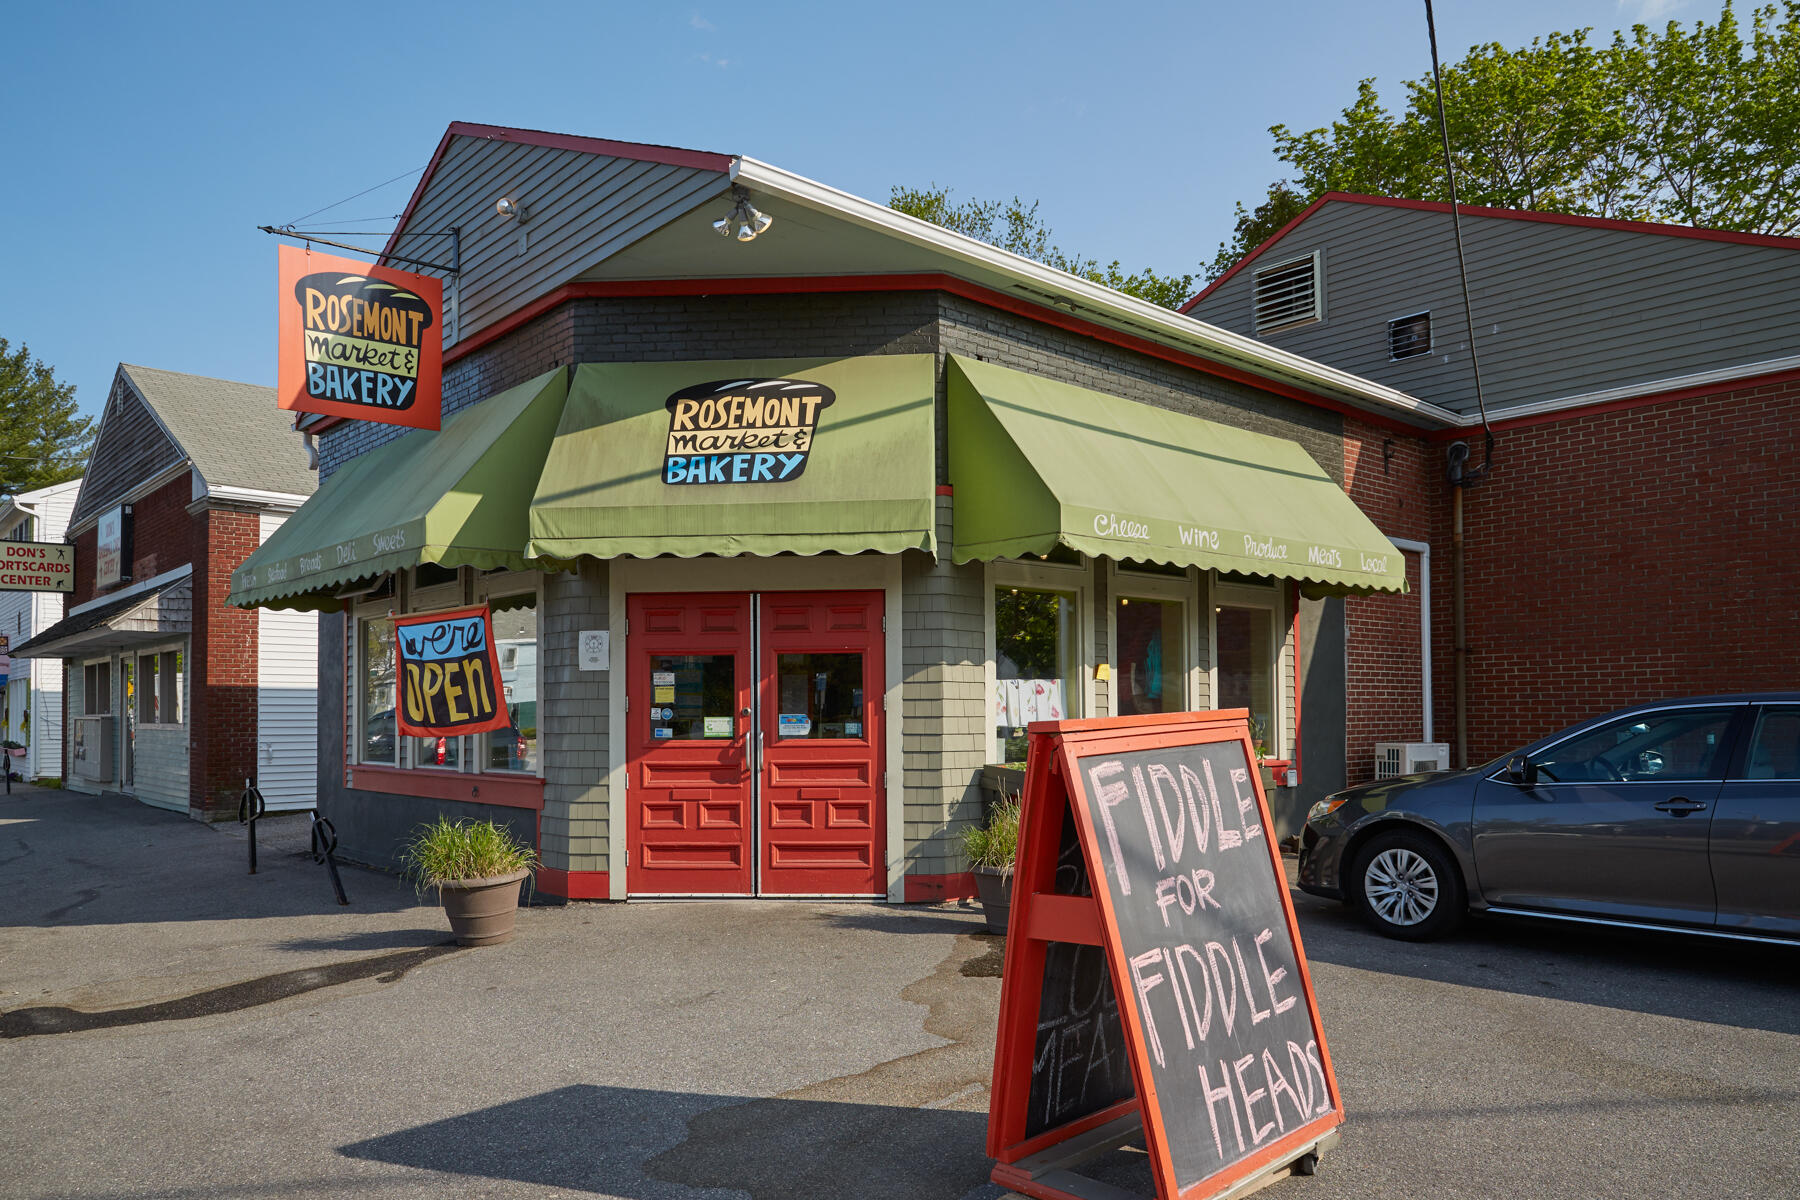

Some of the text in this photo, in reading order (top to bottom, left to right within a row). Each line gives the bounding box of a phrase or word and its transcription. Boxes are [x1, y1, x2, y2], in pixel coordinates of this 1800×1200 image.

[306, 287, 424, 346] ROSEMONT
[308, 362, 414, 406] BAKERY
[673, 396, 822, 430] ROSEMONT
[667, 453, 805, 484] BAKERY
[7, 546, 46, 559] DON'S
[336, 541, 357, 565] Deli
[373, 529, 406, 555] Sweets
[1093, 514, 1150, 540] Cheese
[1178, 525, 1220, 550] Wine
[1243, 534, 1288, 560] Produce
[1361, 552, 1389, 574] Local
[1, 574, 52, 586] CENTER
[1088, 758, 1262, 896] FIDDLE
[1155, 868, 1221, 928] FOR
[1129, 928, 1297, 1069] FIDDLE
[1198, 1040, 1329, 1159] HEADS
